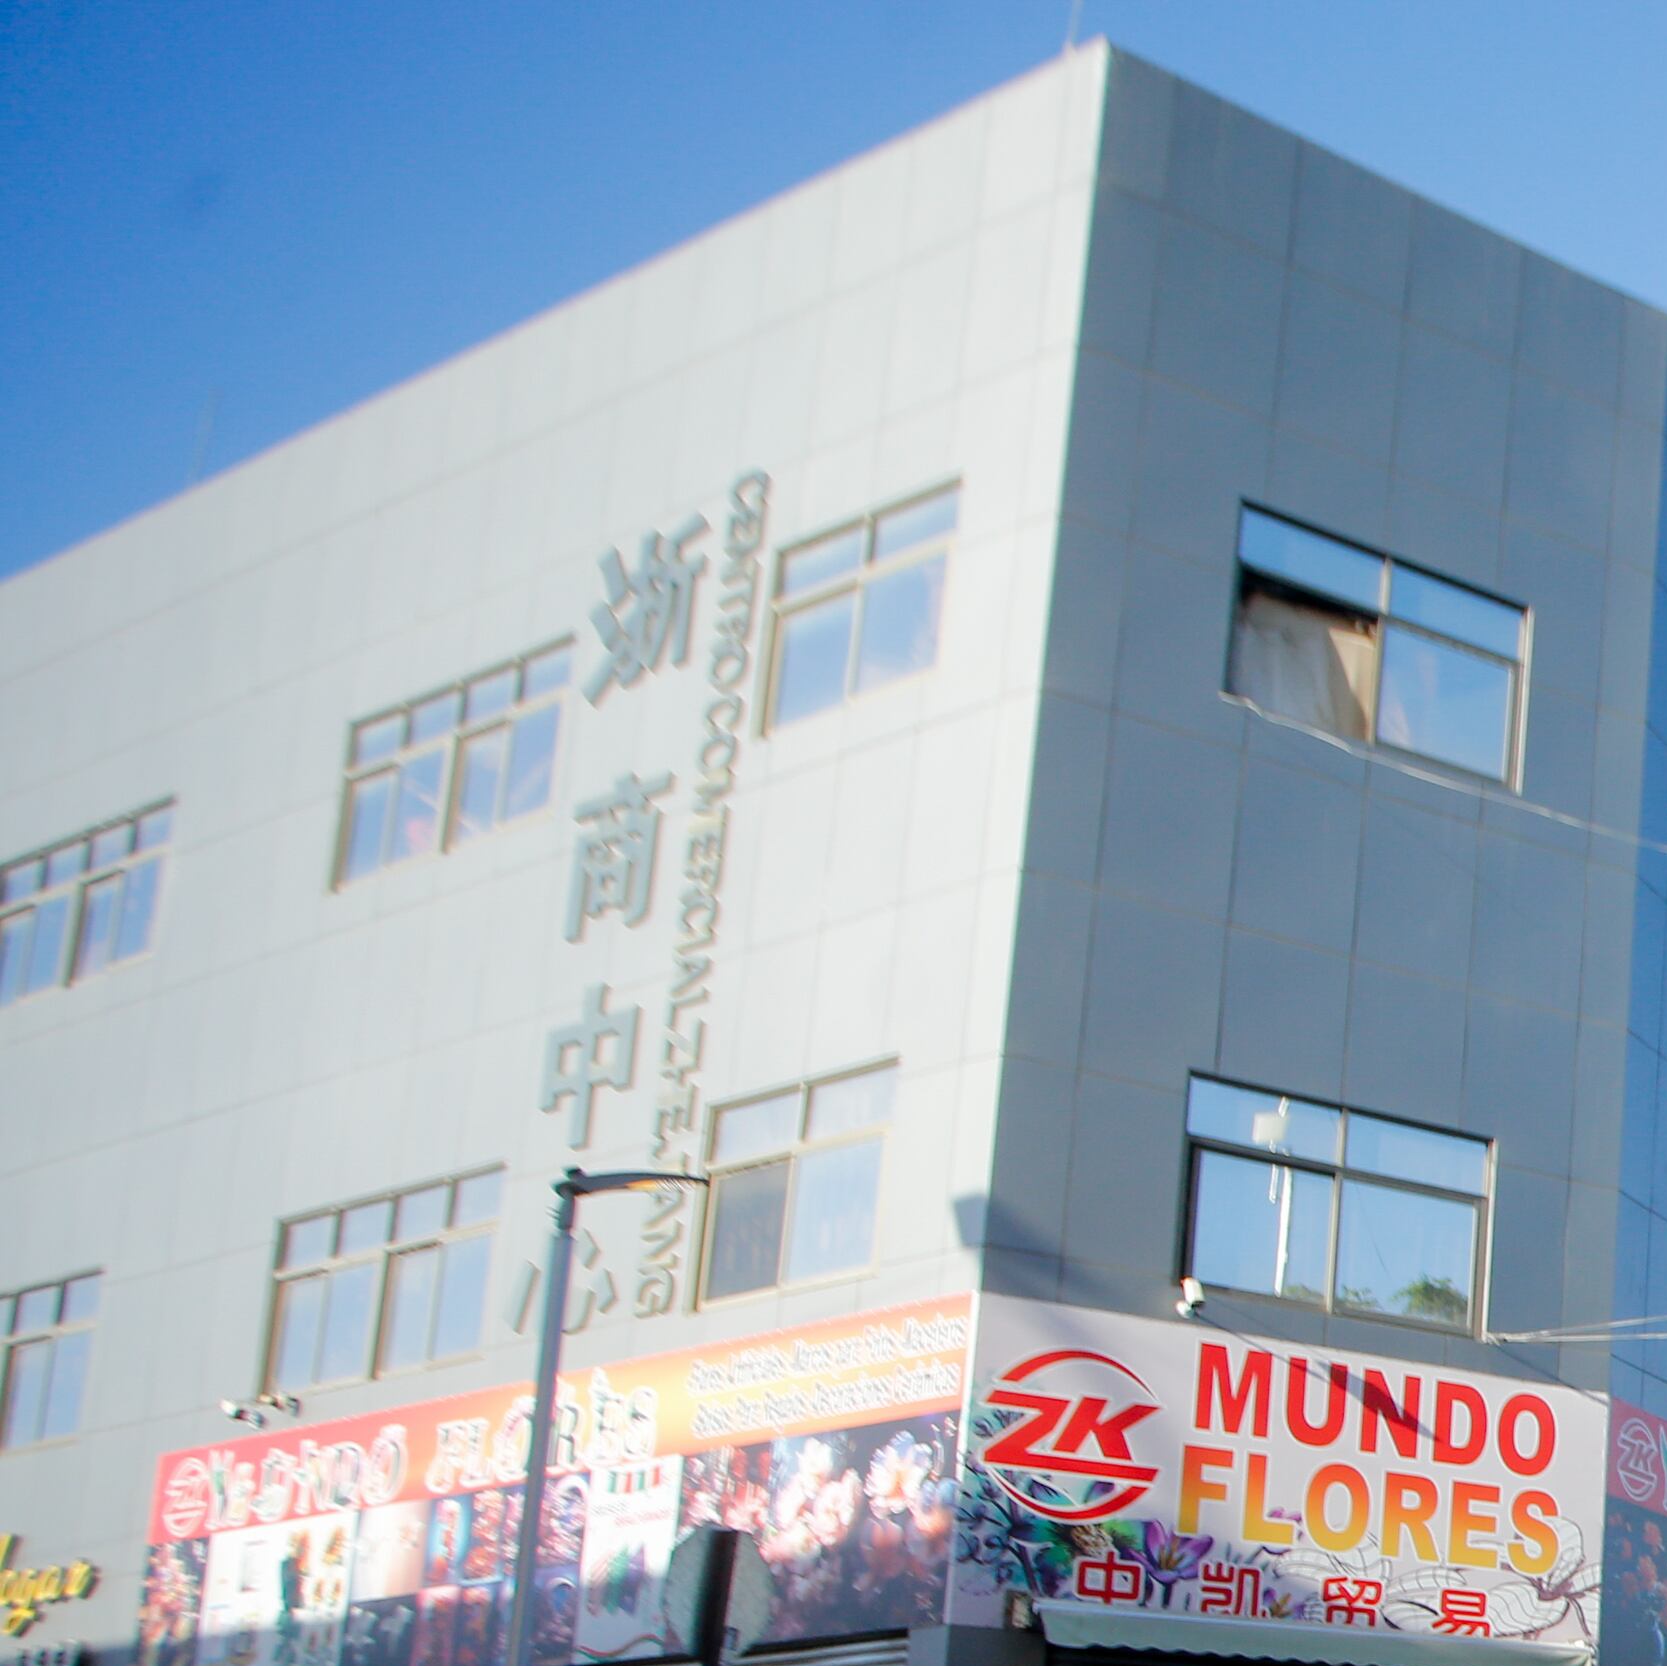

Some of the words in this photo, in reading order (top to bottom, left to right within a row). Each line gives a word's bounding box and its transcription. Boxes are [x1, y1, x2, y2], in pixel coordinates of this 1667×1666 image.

[983, 1388, 1160, 1482] ZK
[1193, 1340, 1558, 1477] MUNDO
[1175, 1443, 1561, 1576] FLORES
